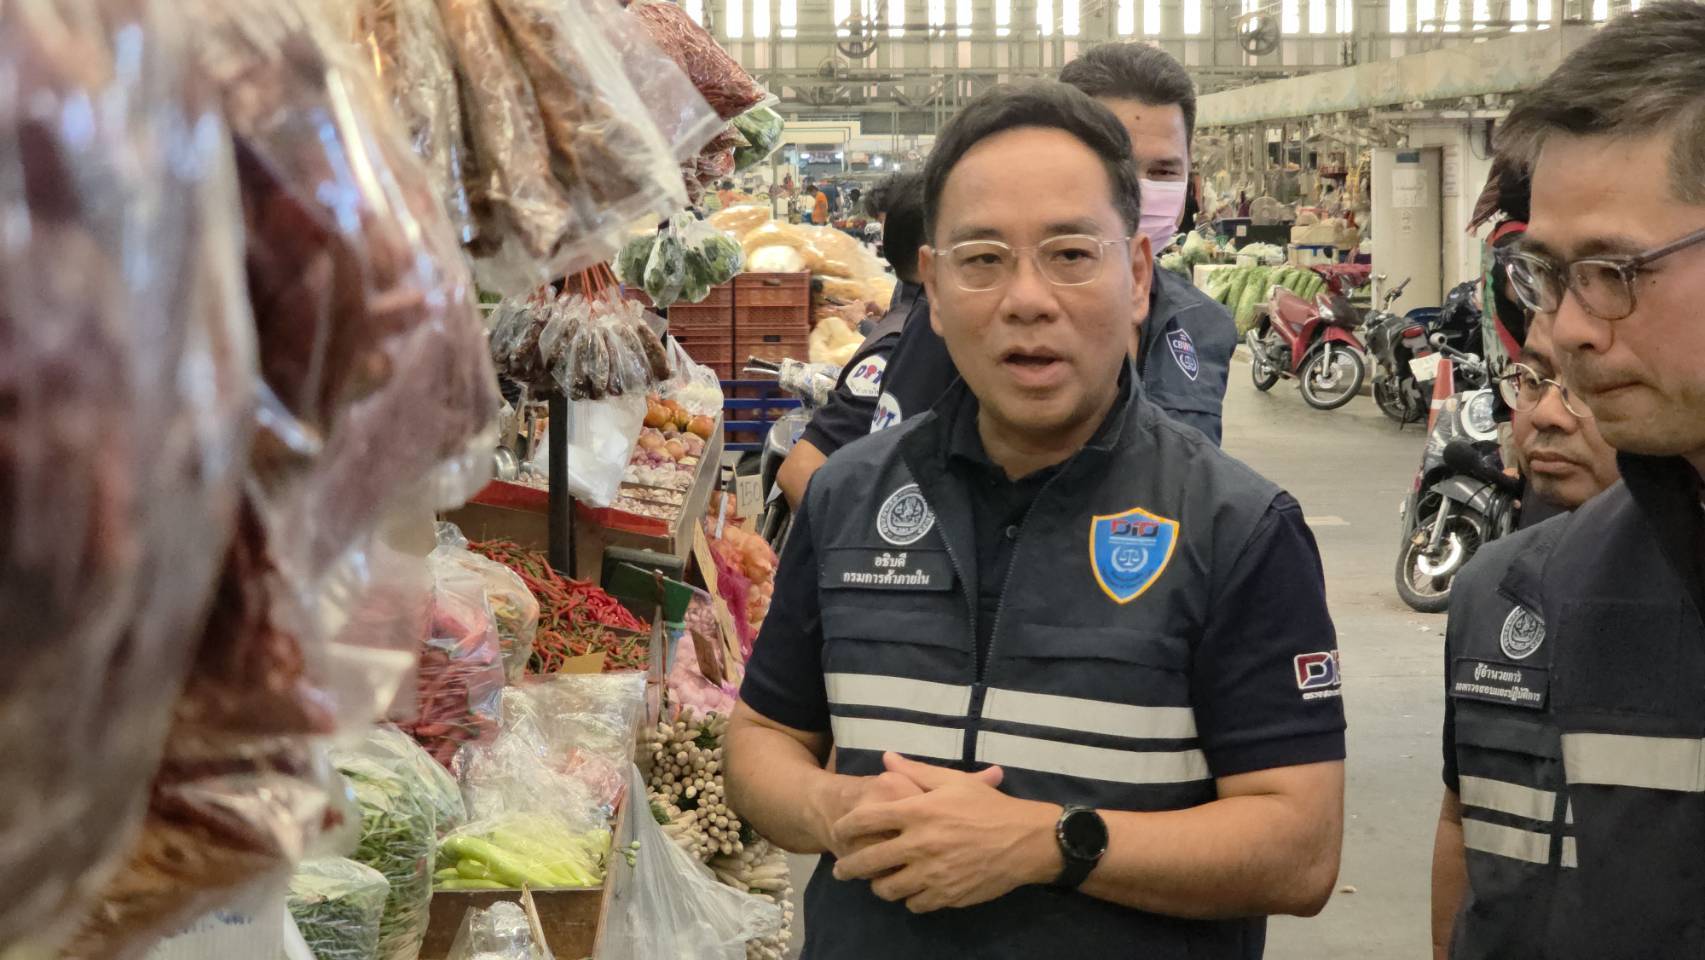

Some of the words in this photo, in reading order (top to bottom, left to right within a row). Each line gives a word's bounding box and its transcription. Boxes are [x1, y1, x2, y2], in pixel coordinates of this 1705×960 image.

[740, 480, 760, 506] 150
[874, 552, 907, 567] อธิบดี
[843, 569, 930, 585] กรมการค้าภายใน
[1474, 662, 1522, 683] ผู้อำนวยการ
